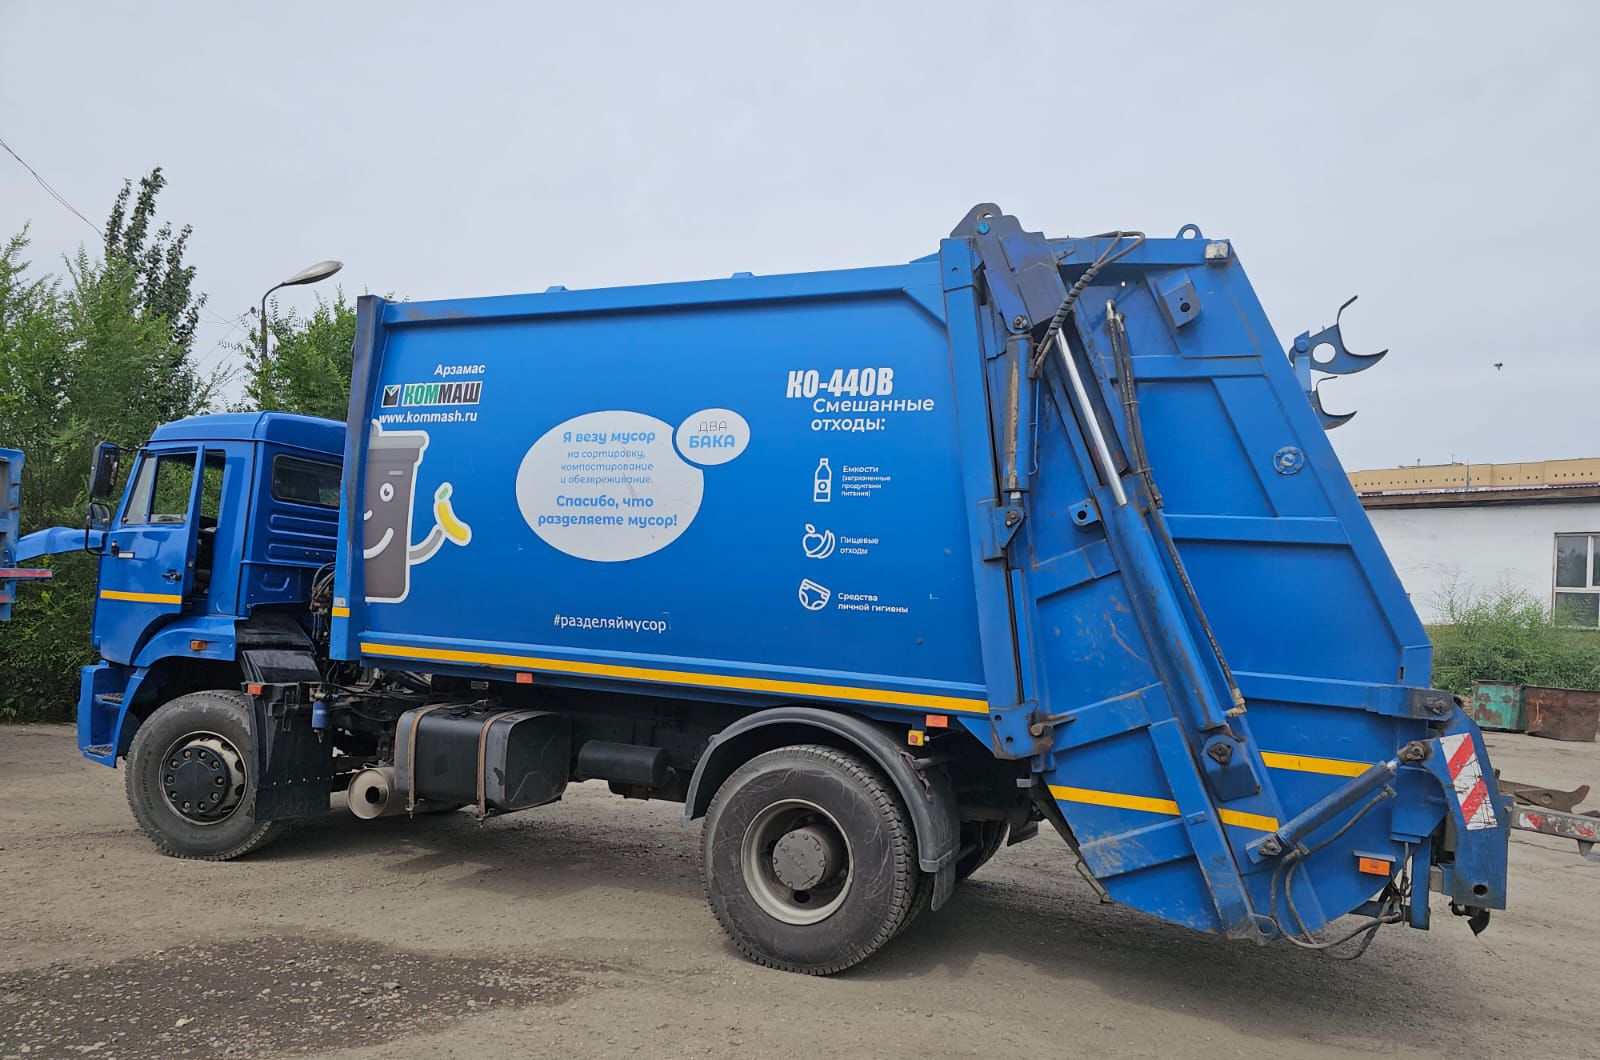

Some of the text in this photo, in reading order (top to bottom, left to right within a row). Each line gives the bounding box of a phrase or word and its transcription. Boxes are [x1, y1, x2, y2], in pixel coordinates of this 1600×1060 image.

[433, 364, 486, 378] Арзамас
[402, 382, 482, 406] КОММАШ
[812, 398, 935, 413] Смешанные
[379, 409, 478, 423] www.kommash.ru
[698, 420, 728, 433] ДВА
[810, 417, 886, 433] отходы:
[563, 431, 656, 444] Я везу мусор
[689, 434, 735, 449] БАКА
[581, 449, 646, 460] сортировку,
[560, 462, 654, 473] компостирование
[842, 465, 879, 473] Емкости
[560, 476, 567, 484] и
[556, 495, 654, 509] Спасибо, что
[538, 514, 678, 528] разделяете мусор!
[840, 536, 880, 545] Пищевые
[839, 547, 868, 555] отходы
[837, 592, 878, 602] Средства
[837, 603, 909, 613] личной гигиены
[553, 614, 667, 634] #разделяймусор
